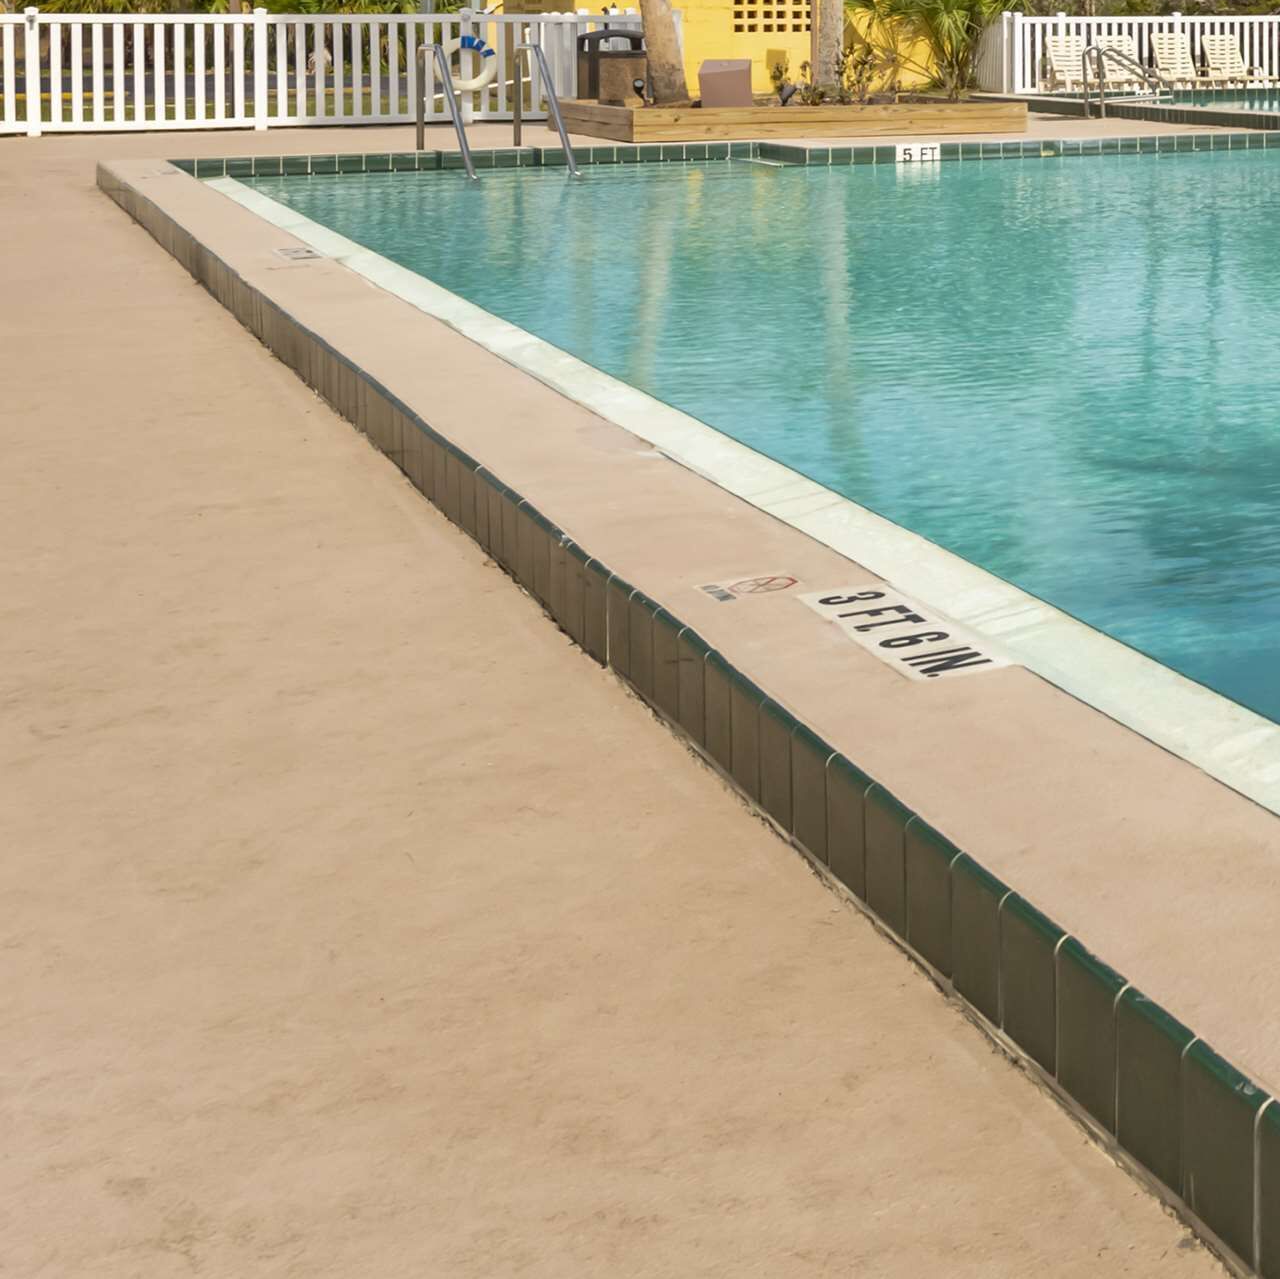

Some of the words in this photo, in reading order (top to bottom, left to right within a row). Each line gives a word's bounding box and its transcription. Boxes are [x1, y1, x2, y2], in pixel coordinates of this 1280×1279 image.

[903, 148, 912, 161] 5
[920, 146, 937, 161] FT
[818, 591, 886, 605] 3
[838, 604, 926, 632] FT.
[878, 631, 949, 649] 6
[900, 646, 993, 677] IN.
